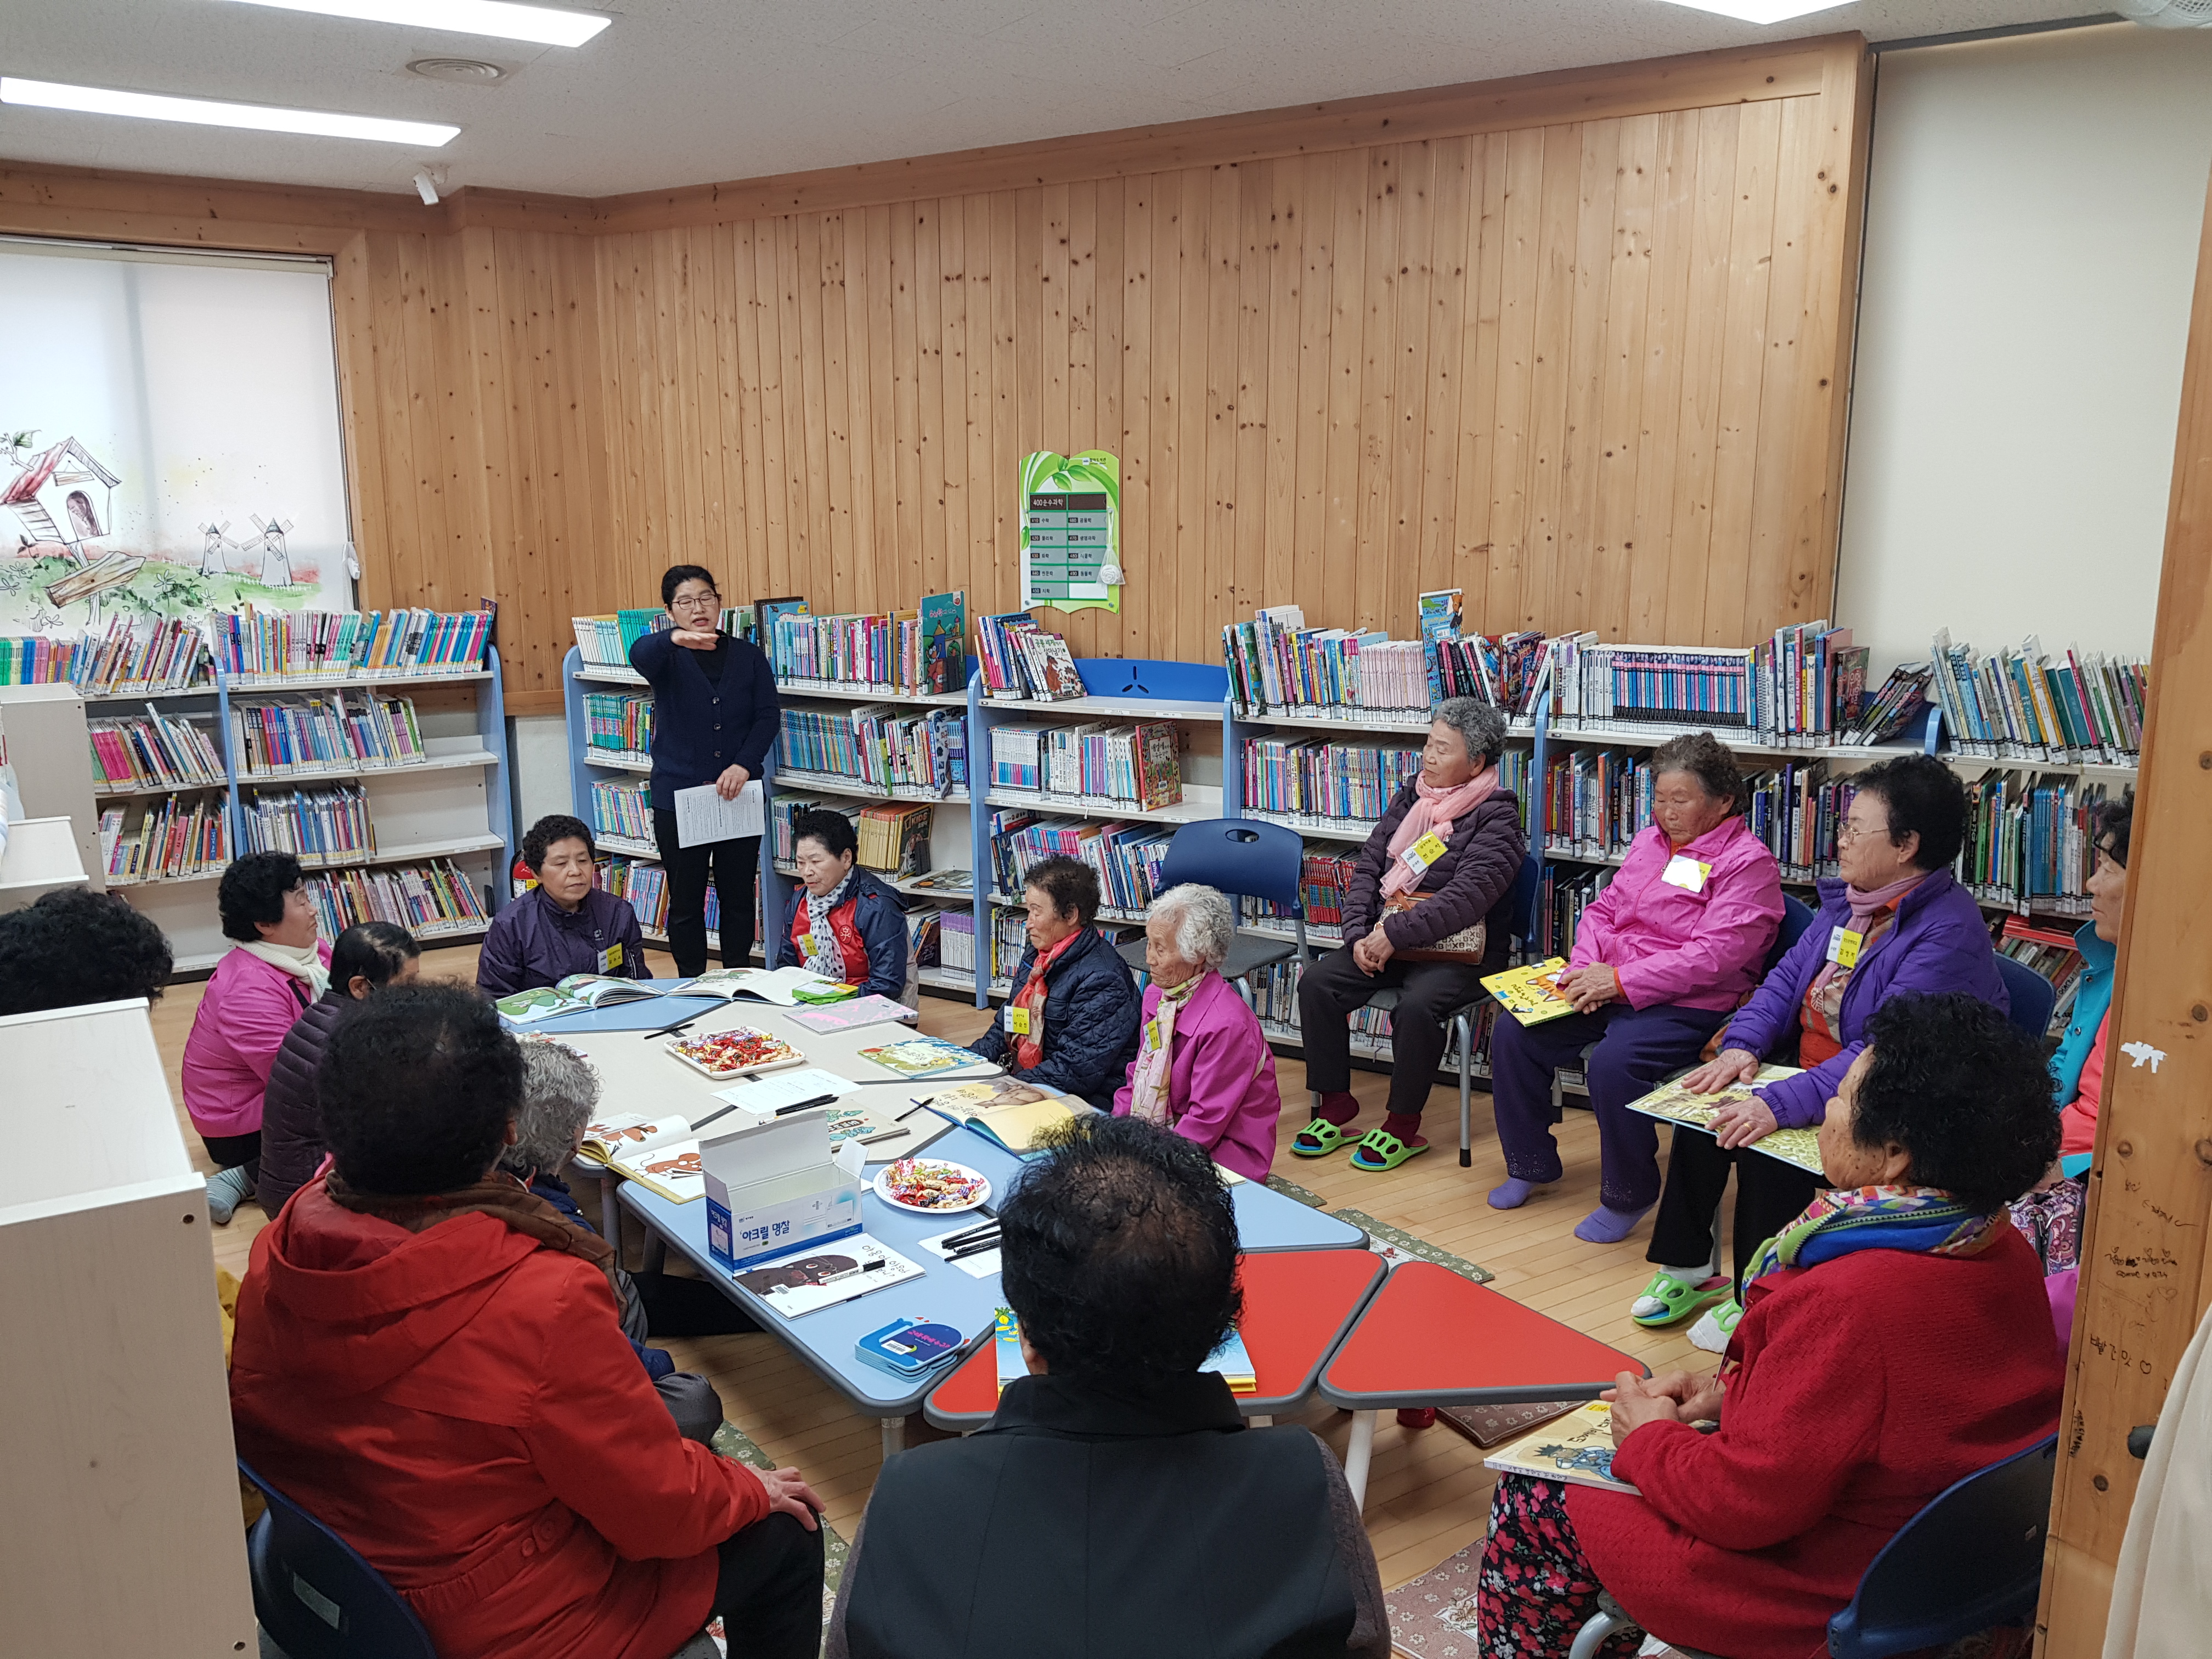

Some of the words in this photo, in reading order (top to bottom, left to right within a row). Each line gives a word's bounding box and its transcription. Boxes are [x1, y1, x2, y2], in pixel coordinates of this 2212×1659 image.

[1035, 639, 1045, 648] 공룡
[1043, 647, 1063, 656] 살아남기
[742, 1225, 769, 1242] 아크릴
[772, 1220, 790, 1236] 명찰
